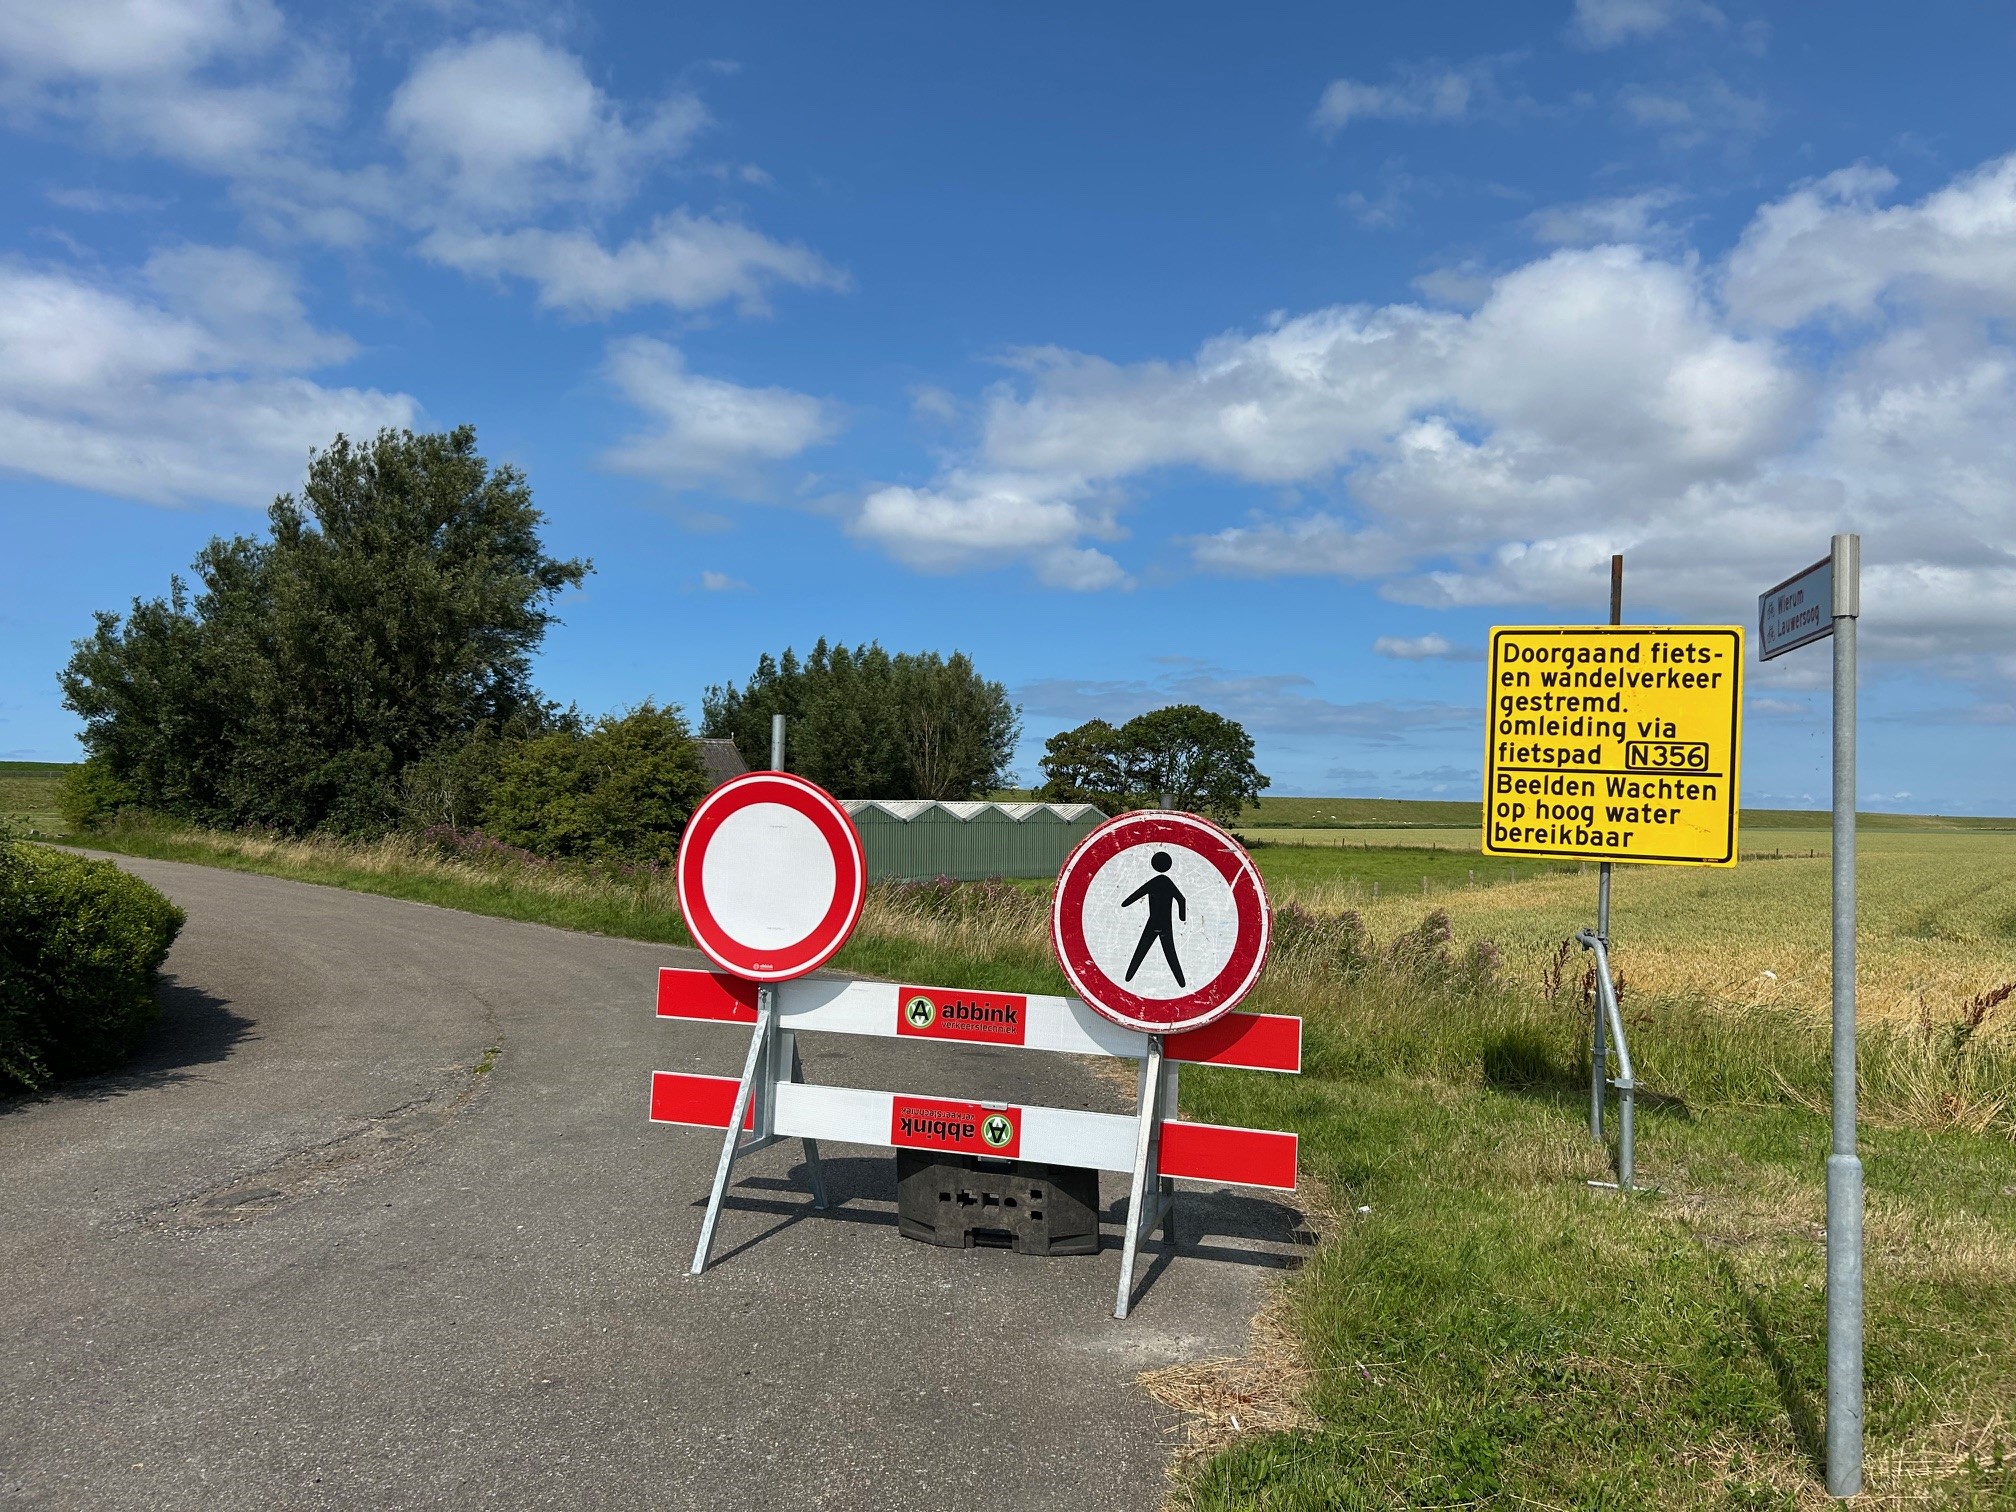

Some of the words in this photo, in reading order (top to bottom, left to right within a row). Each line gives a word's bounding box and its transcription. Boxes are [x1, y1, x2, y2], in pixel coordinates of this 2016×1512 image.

[1777, 589, 1804, 615] Wierum
[1777, 604, 1820, 637] Lauwersoog
[1503, 642, 1640, 670] Doorgaand
[1651, 643, 1723, 664] fiets-
[1501, 671, 1530, 687] en
[1541, 667, 1722, 689] wandelverkeer
[1500, 692, 1628, 717] gestremd.
[1499, 716, 1626, 743] omleiding
[1637, 718, 1676, 738] via
[1498, 742, 1601, 767] fietspad
[1630, 745, 1704, 767] N356
[1497, 774, 1595, 797] Beelden
[1606, 777, 1717, 800] Wachten
[1496, 802, 1525, 821] op
[1536, 799, 1594, 827] hoog
[1606, 804, 1681, 824] water
[1495, 822, 1633, 848] bereikbaar
[941, 1000, 1017, 1024] abbink
[941, 1020, 1017, 1035] verkeerstechniek
[901, 1106, 975, 1121] verkeerstechniek
[900, 1117, 975, 1142] abbink
